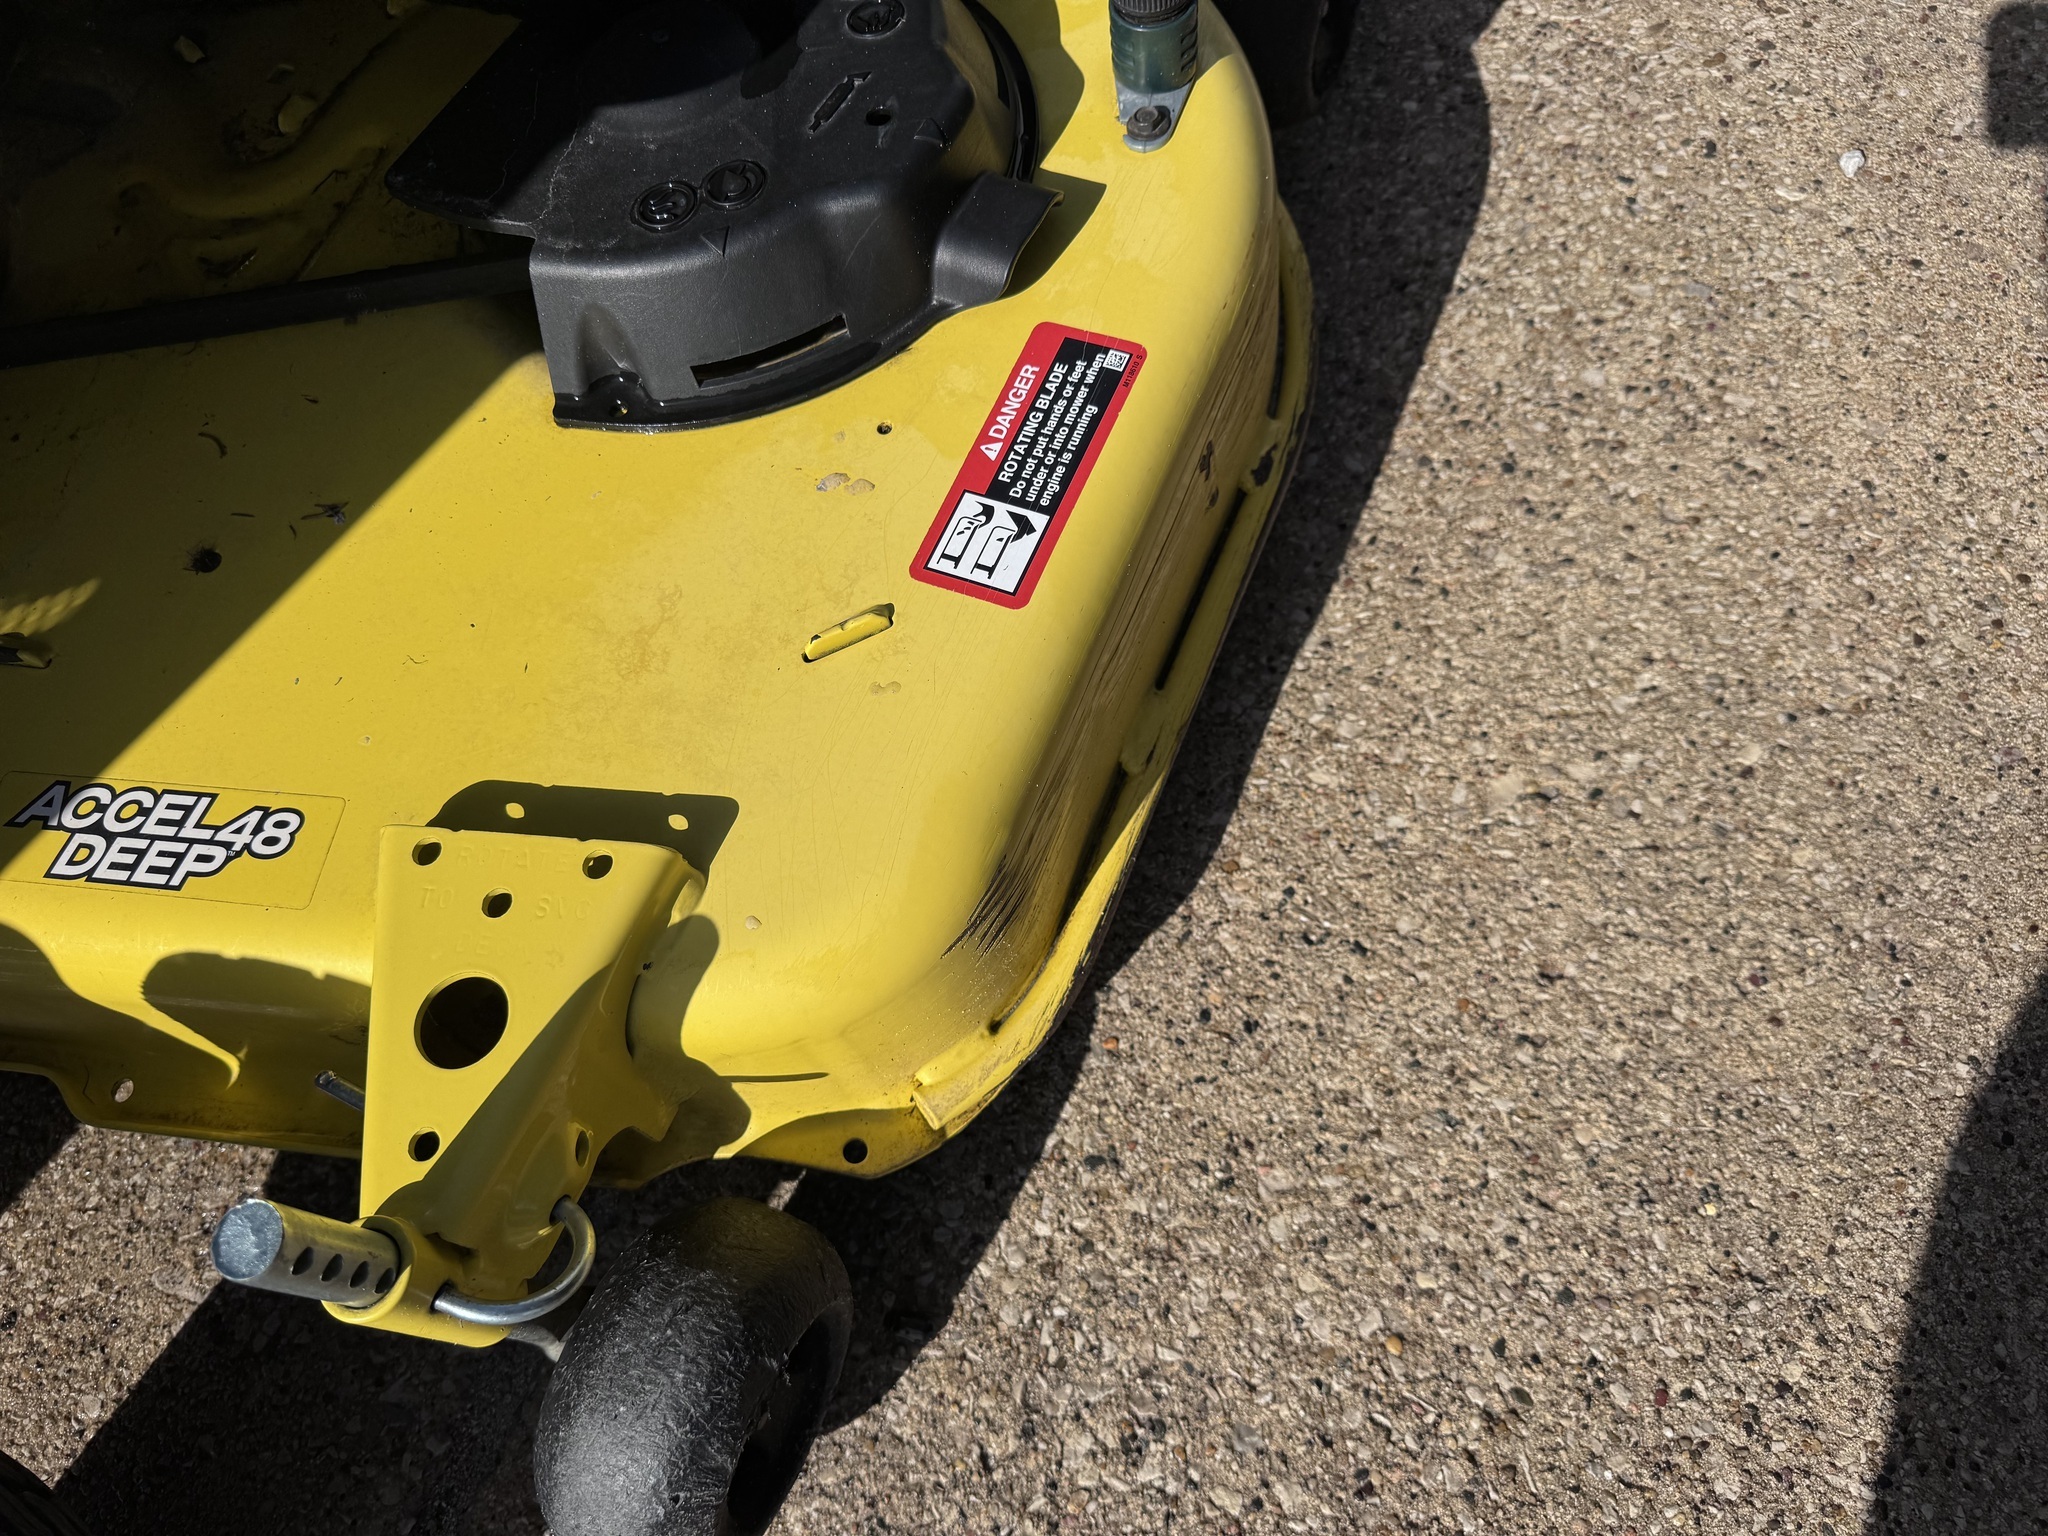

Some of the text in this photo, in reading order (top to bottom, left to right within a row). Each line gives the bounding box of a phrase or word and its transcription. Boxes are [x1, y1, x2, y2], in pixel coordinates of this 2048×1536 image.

[988, 365, 1040, 440] DANGER
[998, 363, 1068, 482] ROTATING BLADE
[1009, 360, 1087, 498] Do not put hands or feet
[1026, 354, 1105, 501] under or into mower when
[1040, 405, 1098, 506] engine is running
[8, 782, 216, 841] ACCEL
[47, 832, 227, 888] DEEP
[421, 885, 454, 909] TO
